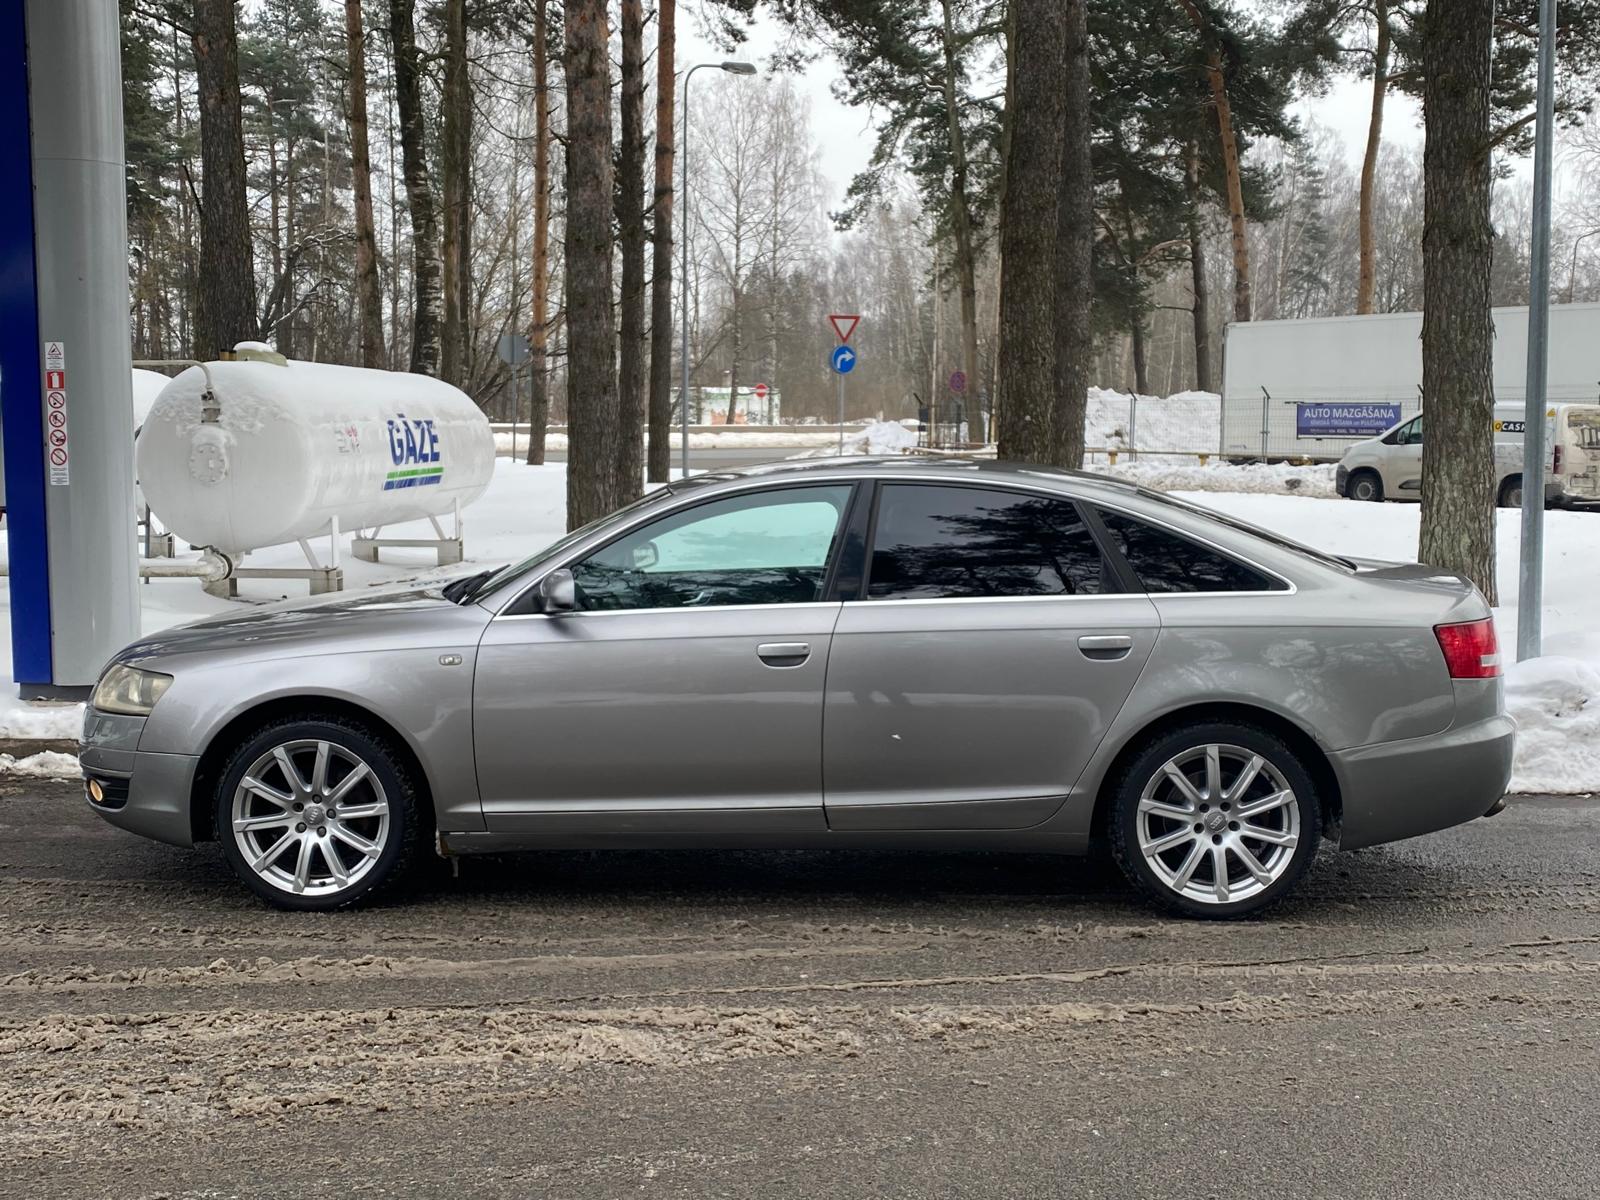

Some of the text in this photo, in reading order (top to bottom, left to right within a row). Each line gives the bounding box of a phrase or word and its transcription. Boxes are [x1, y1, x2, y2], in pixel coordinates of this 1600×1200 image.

[1304, 406, 1395, 419] AUTO MAZGĀŠANA
[387, 413, 440, 466] GĀZE
